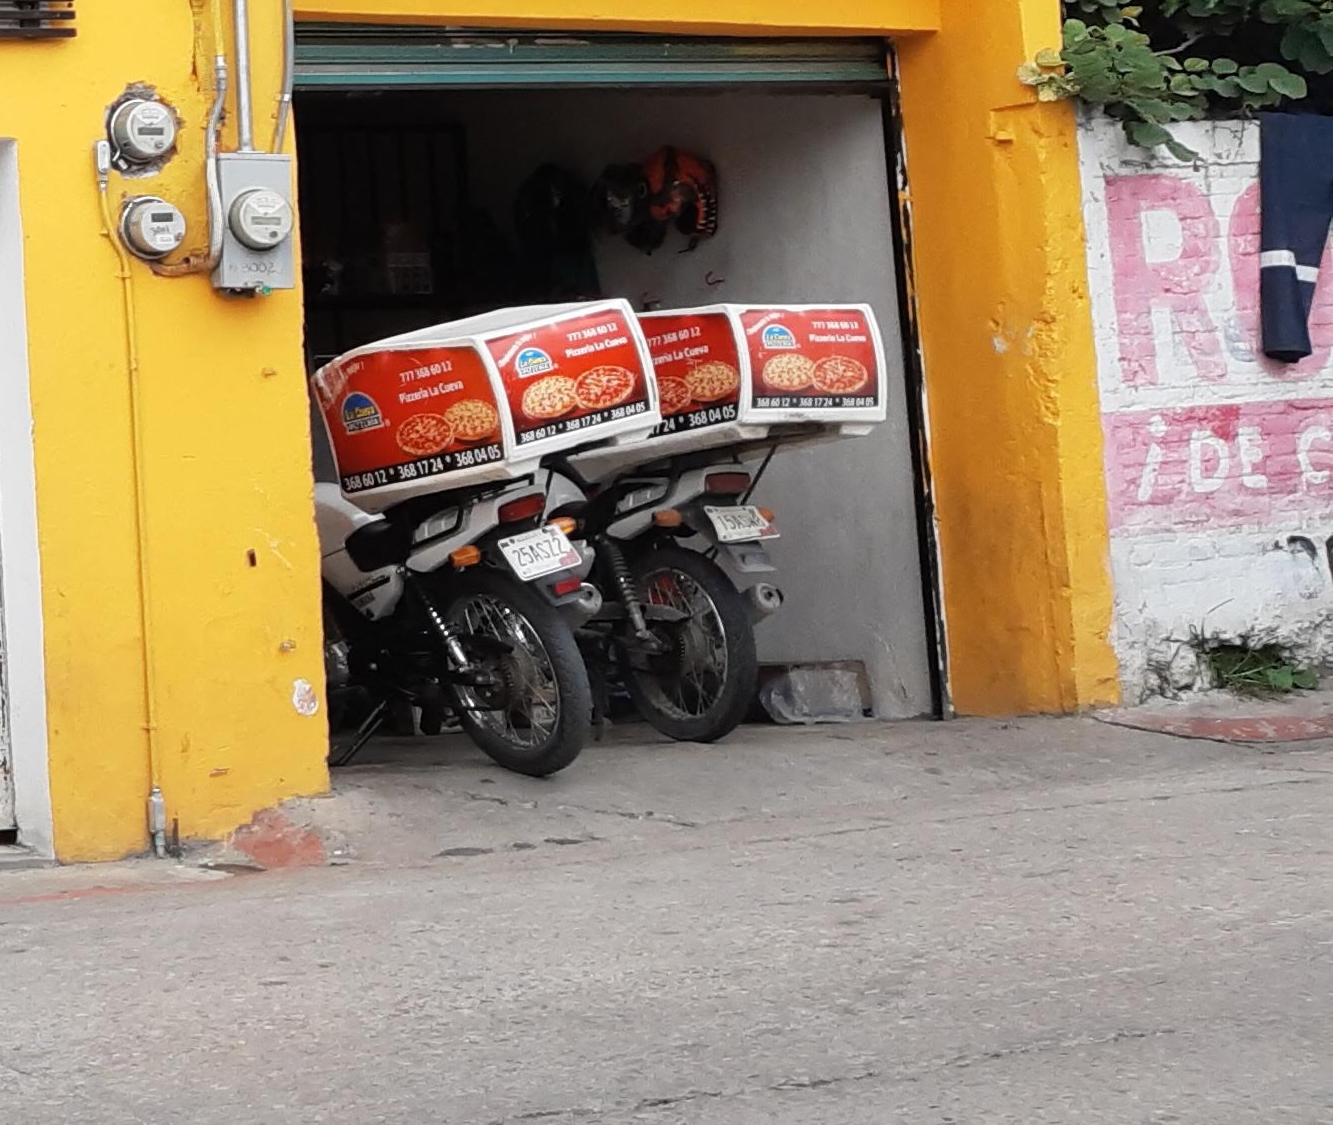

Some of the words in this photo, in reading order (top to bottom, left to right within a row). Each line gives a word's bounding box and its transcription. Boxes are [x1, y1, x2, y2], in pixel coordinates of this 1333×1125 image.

[429, 385, 440, 396] La
[547, 425, 556, 435] 12
[581, 417, 591, 427] 17
[663, 418, 675, 432] 24
[689, 412, 708, 427] 368
[709, 408, 721, 421] 04
[723, 405, 735, 418] 05
[345, 475, 362, 490] 368
[363, 474, 375, 487] 60
[375, 470, 387, 484] 12
[398, 465, 415, 480] 368
[417, 461, 430, 475] 17
[431, 458, 444, 472] 24
[455, 452, 474, 466] 368
[475, 449, 488, 463] 04
[488, 445, 501, 459] 05
[513, 538, 569, 566] 25ASZ2
